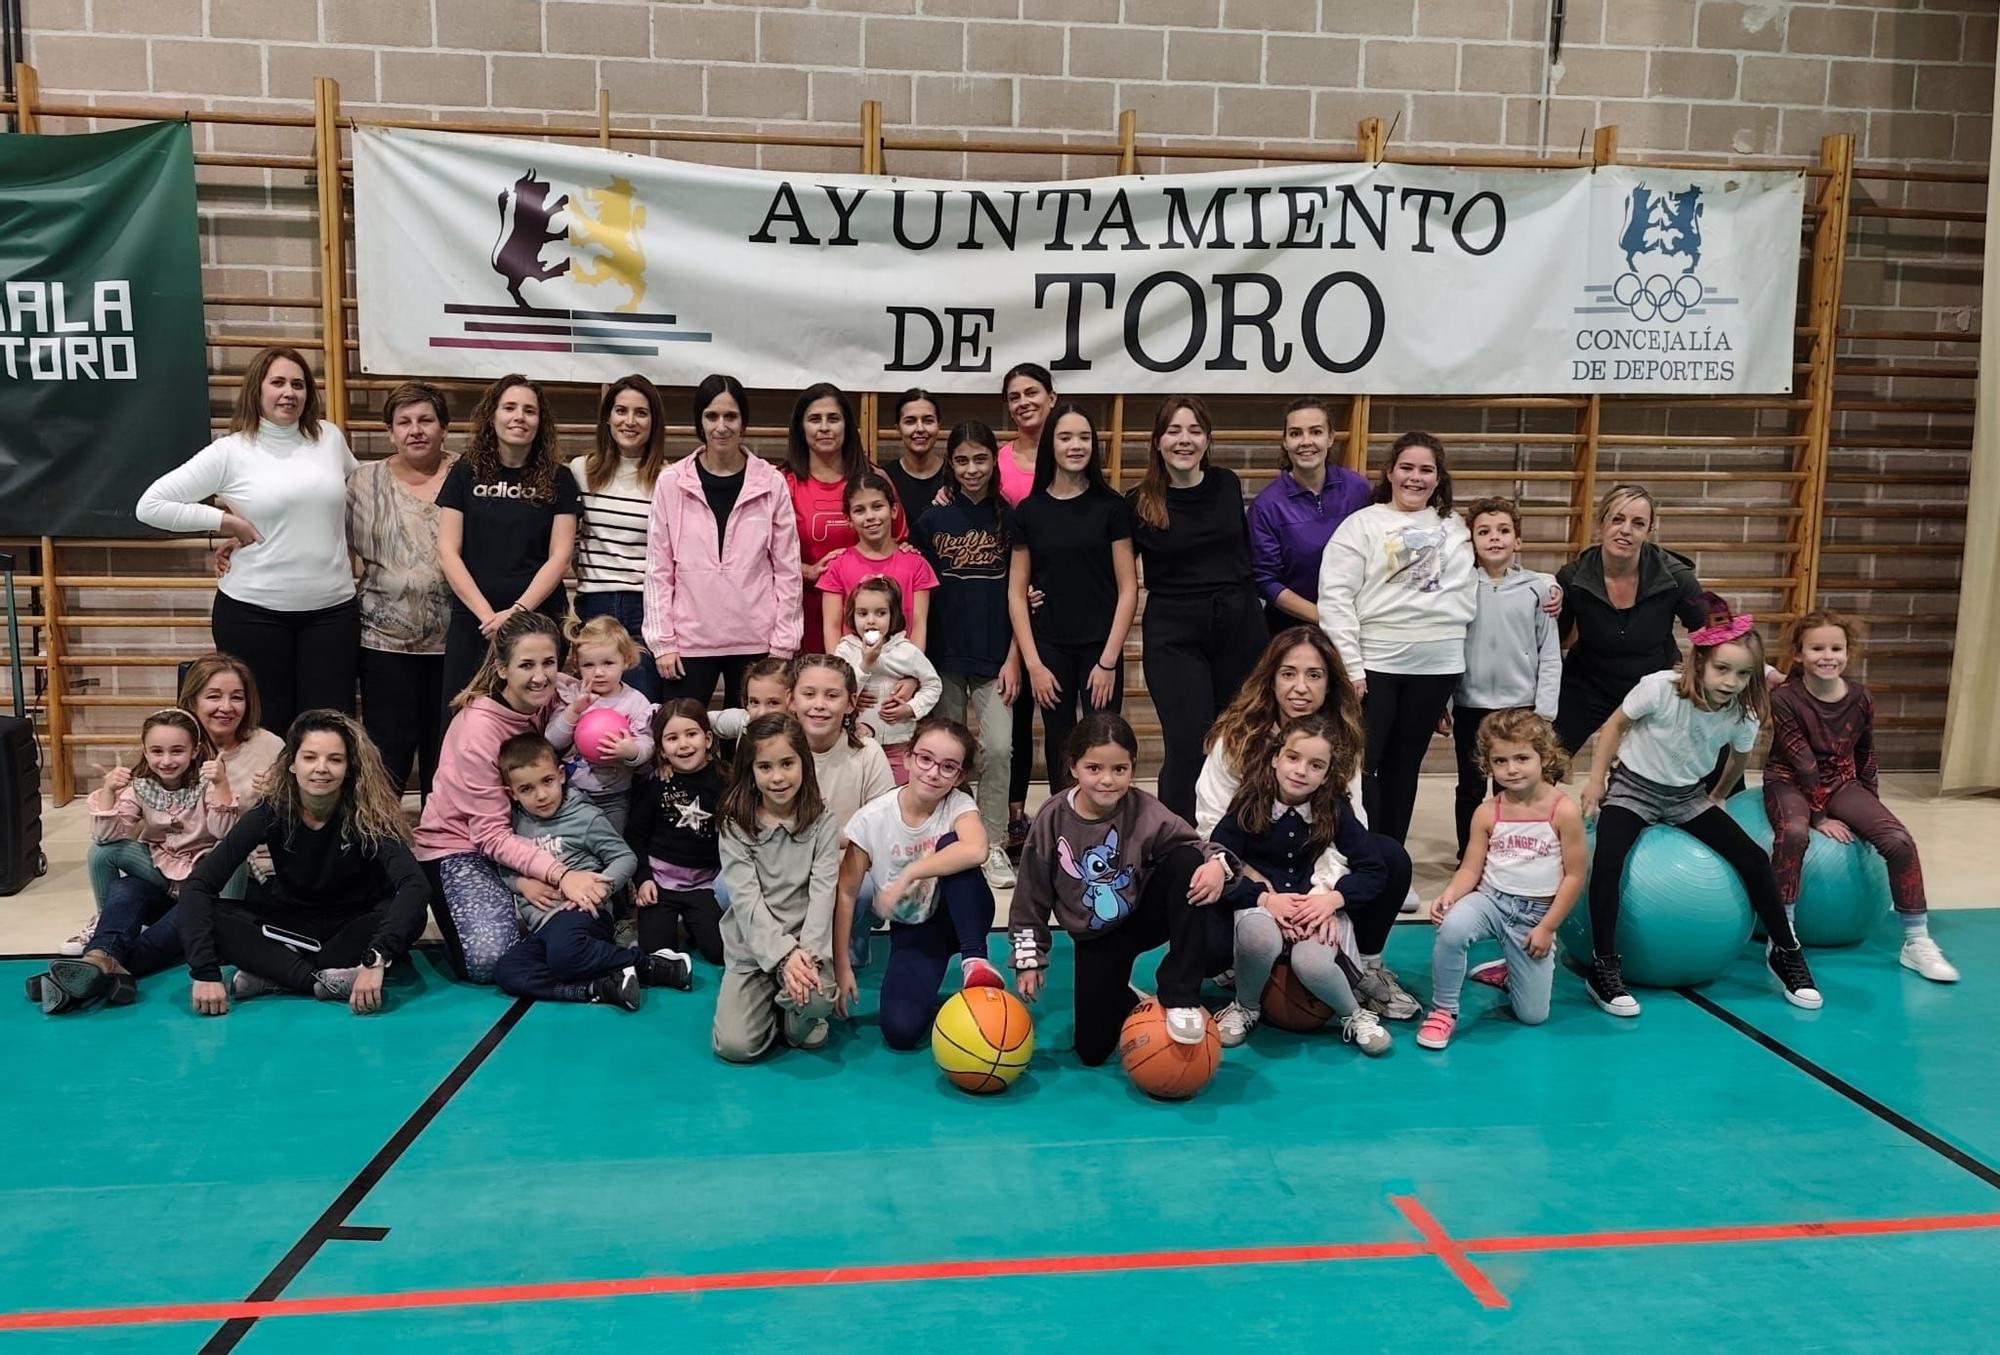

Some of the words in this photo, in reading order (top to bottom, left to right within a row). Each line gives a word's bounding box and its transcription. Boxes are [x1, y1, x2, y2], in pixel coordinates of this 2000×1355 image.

[748, 181, 1507, 257] AYUNTAMIENTO
[0, 280, 134, 333] ALA
[884, 305, 995, 373] DE
[1034, 270, 1386, 374] TORO
[1576, 326, 1733, 353] CONCEJALÍA
[1572, 360, 1607, 381] DE
[1613, 360, 1735, 382] DEPORTES
[472, 481, 553, 502] adida
